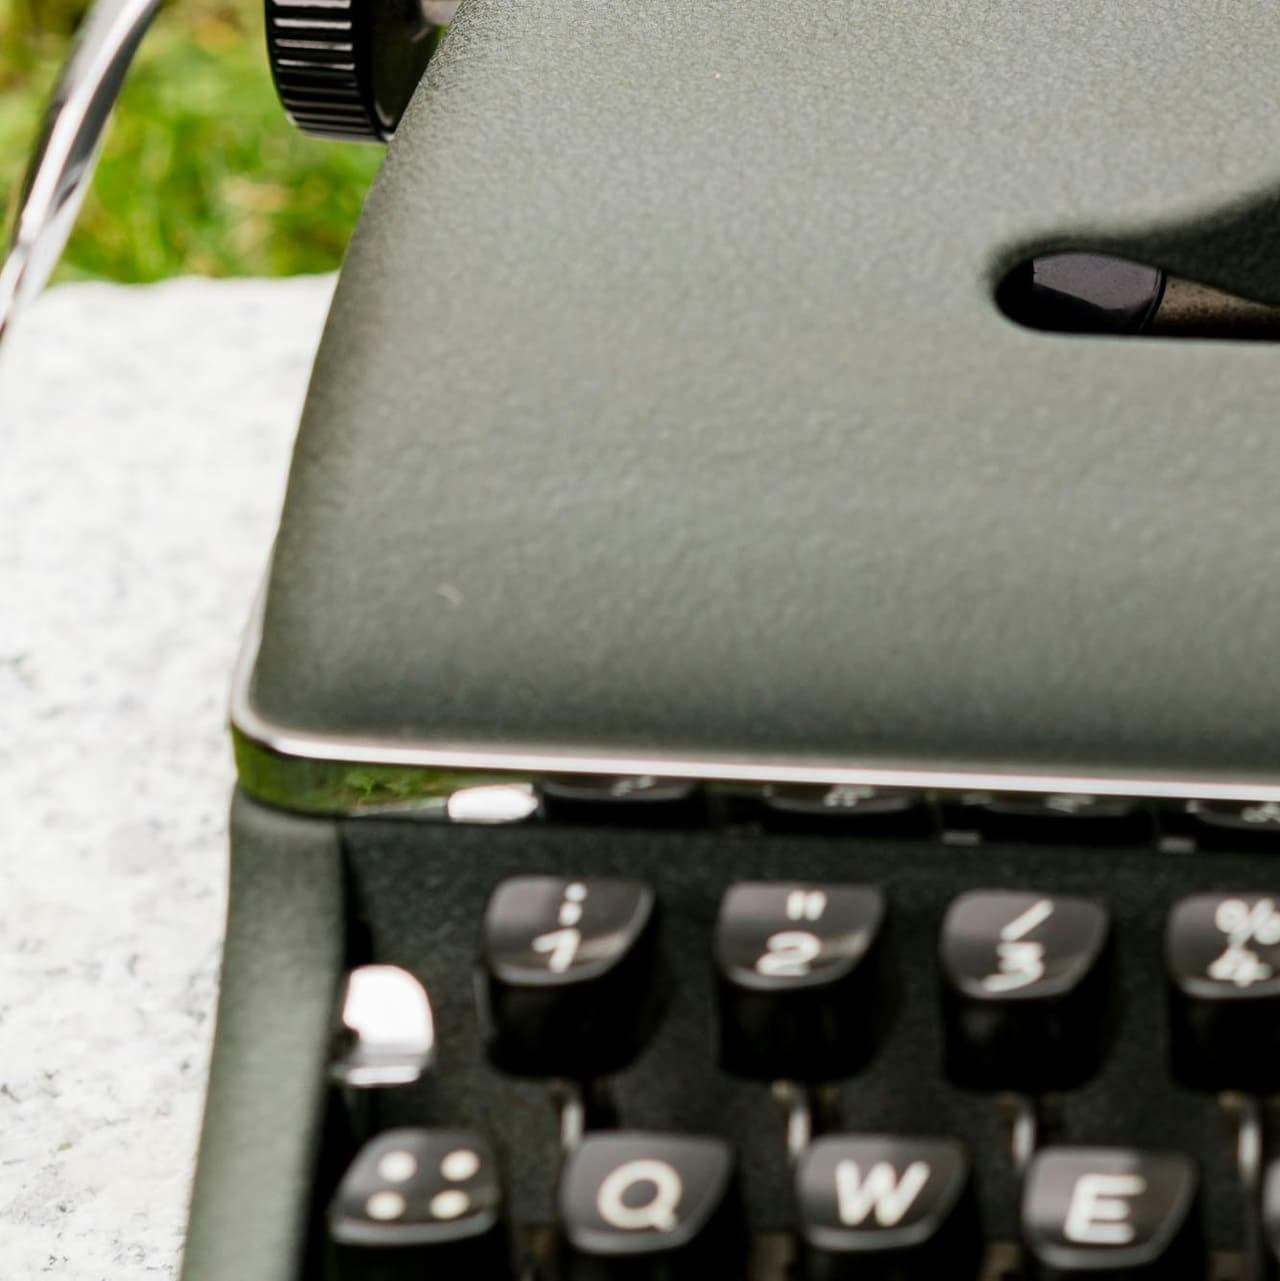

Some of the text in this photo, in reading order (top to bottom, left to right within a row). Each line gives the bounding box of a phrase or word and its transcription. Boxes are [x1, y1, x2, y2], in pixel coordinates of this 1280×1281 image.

[531, 928, 581, 974] 1
[757, 931, 823, 978] 2
[982, 942, 1046, 993] 3
[1207, 944, 1274, 989] 4
[596, 1158, 682, 1233] Q
[832, 1158, 931, 1226] W
[1063, 1173, 1146, 1244] E
